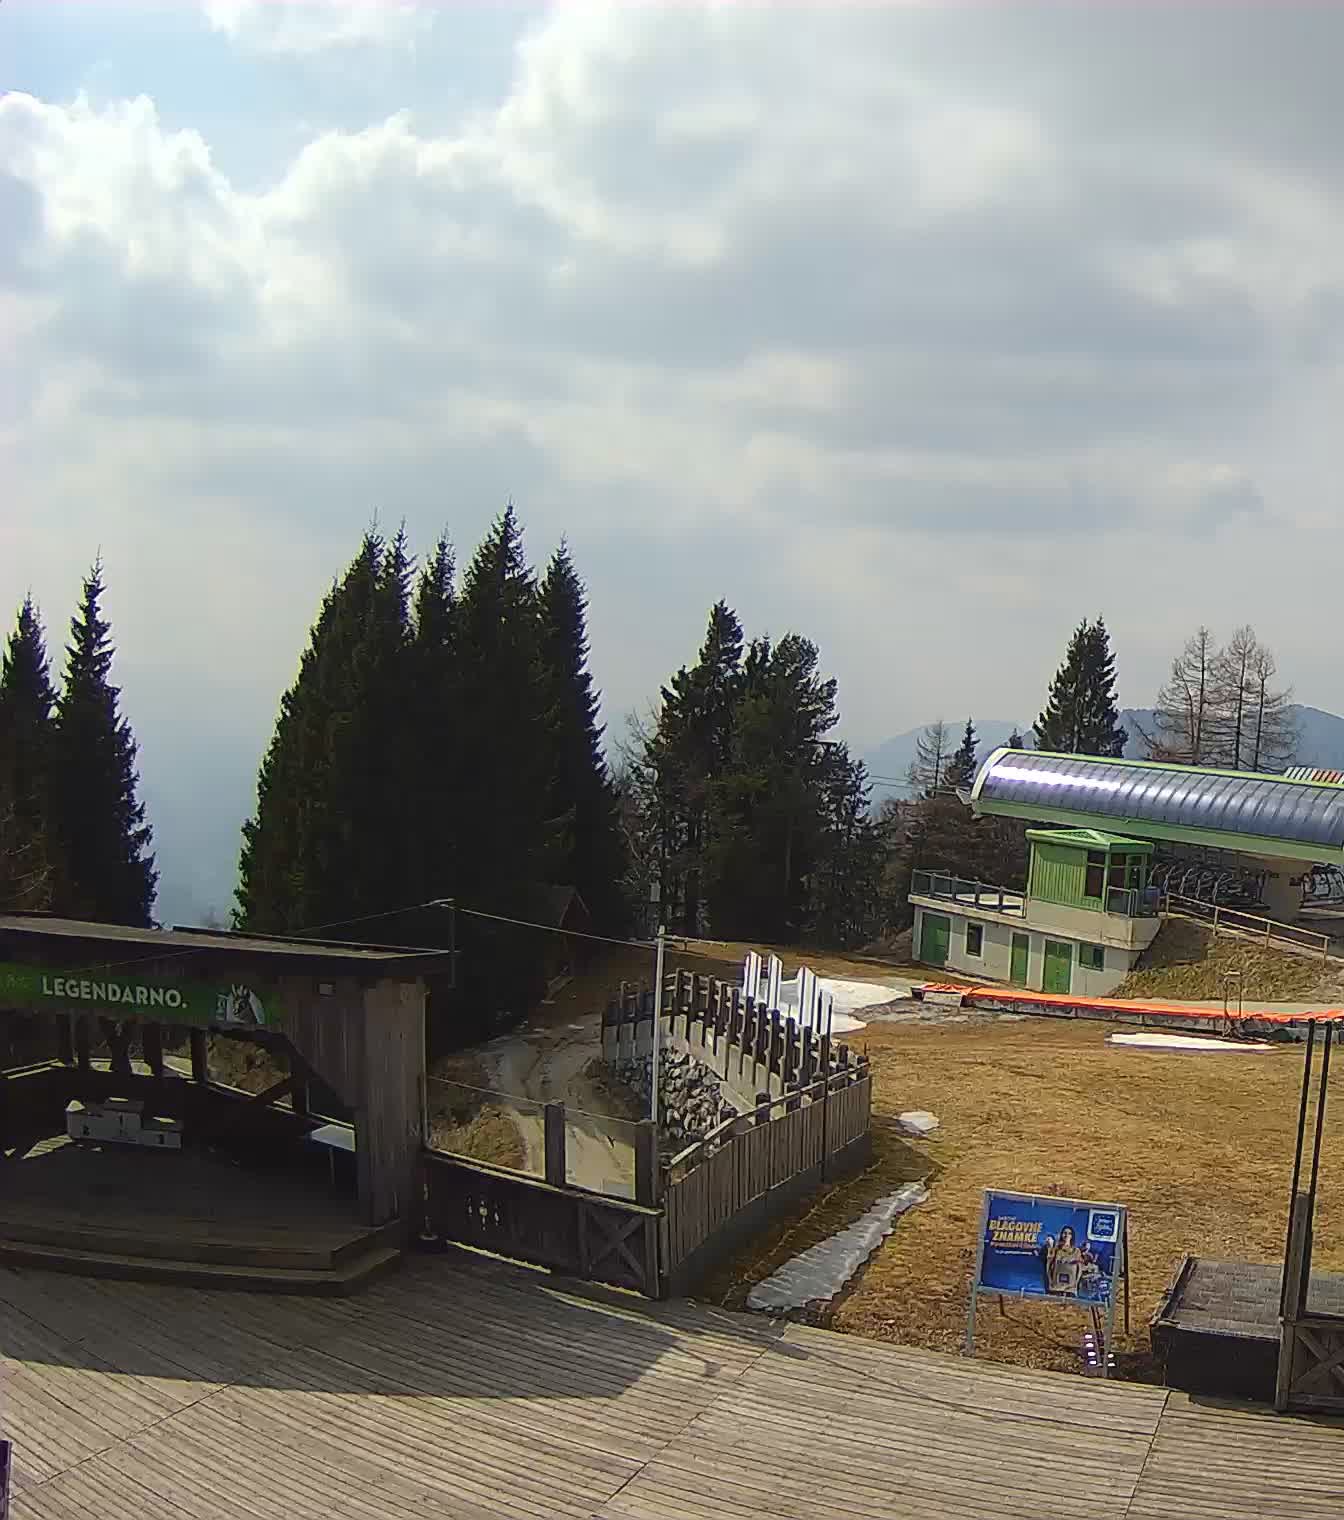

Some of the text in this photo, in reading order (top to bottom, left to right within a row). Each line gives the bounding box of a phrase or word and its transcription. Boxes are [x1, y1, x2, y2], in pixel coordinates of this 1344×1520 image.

[41, 976, 188, 1009] LEGENDARNO.
[989, 1219, 1042, 1232] BLAGOVNE
[992, 1231, 1038, 1242] ZNAMKE
